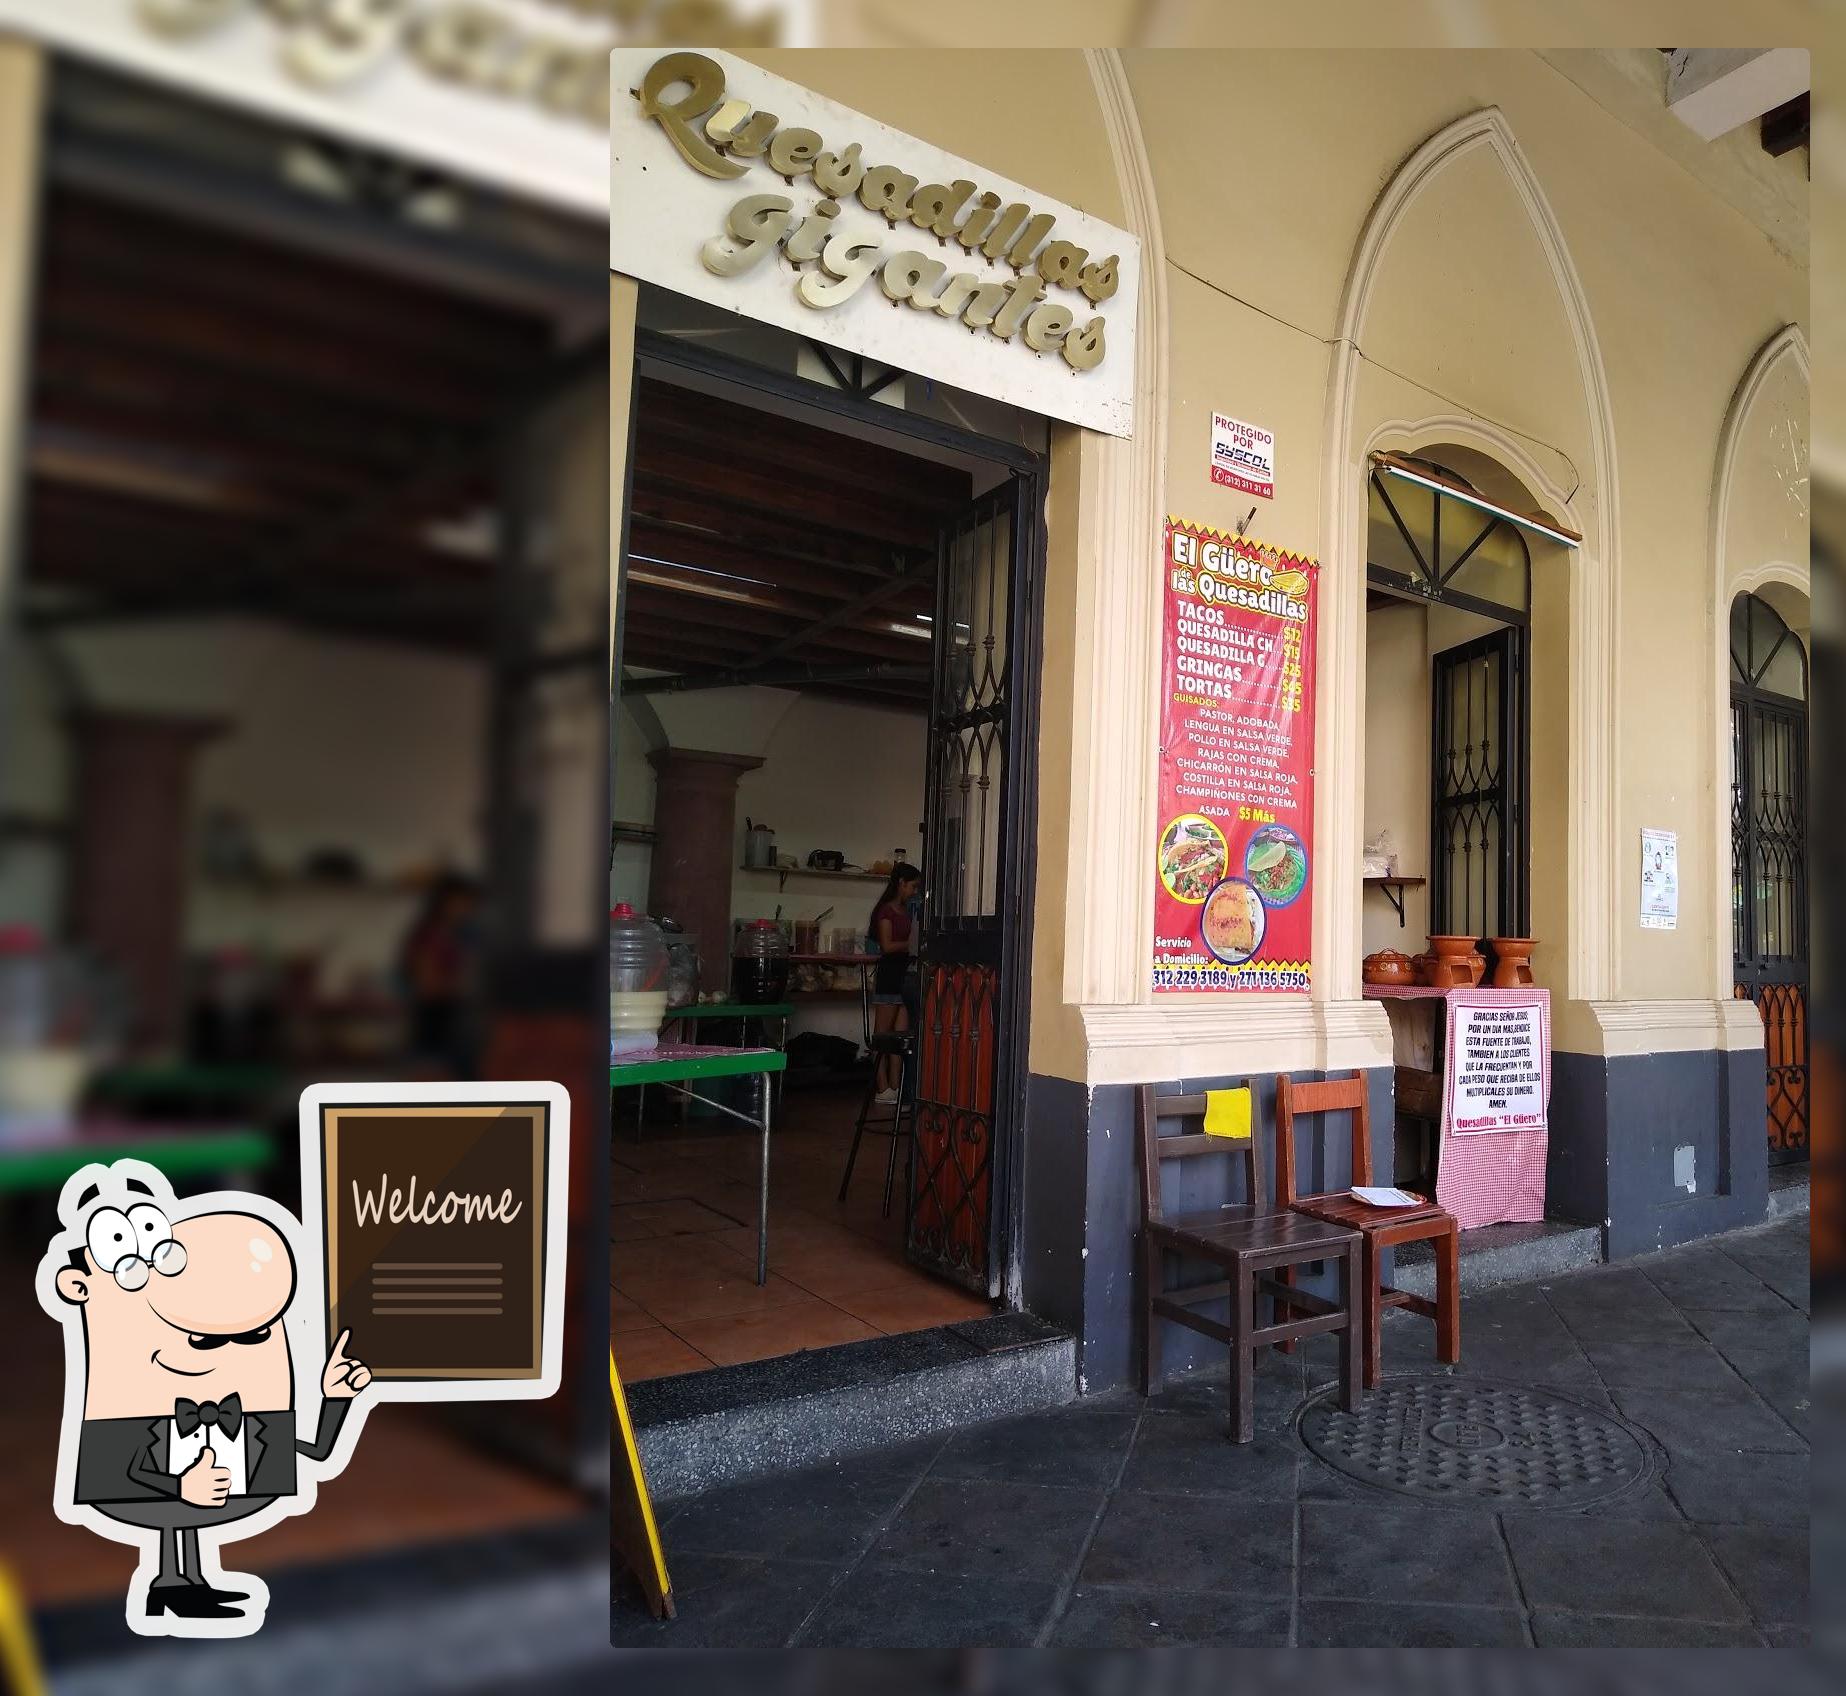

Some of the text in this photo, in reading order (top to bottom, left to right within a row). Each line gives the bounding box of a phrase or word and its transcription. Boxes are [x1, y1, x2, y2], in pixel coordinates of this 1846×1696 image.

[639, 51, 1120, 302] Quesadillas
[1215, 416, 1272, 444] PROTEGIDO
[1233, 434, 1253, 449] POR
[1215, 442, 1270, 470] SYSCOL
[1225, 475, 1240, 487] (312)
[1242, 480, 1252, 490] 311
[1174, 532, 1273, 586] El Güero
[1172, 570, 1195, 593] las
[1198, 572, 1307, 620] Quesadillas
[1177, 600, 1225, 625] TACOS
[1177, 619, 1254, 648] QUESADILLA
[1257, 637, 1273, 652] CH
[1177, 637, 1255, 664] QUESADILLA
[1177, 656, 1242, 682] GRINGAS
[1177, 675, 1232, 699] TORTAS
[1185, 719, 1220, 734] LENGUA
[1222, 726, 1235, 736] EN
[1237, 727, 1264, 740] SALSA
[1189, 732, 1216, 746] POLLO
[1219, 739, 1231, 749] EN
[1233, 740, 1260, 753] SALSA
[1198, 747, 1224, 761] RAJAS
[1226, 752, 1247, 763] CON
[1177, 758, 1232, 775] CHICARRÓN
[1234, 766, 1247, 776] EN
[1249, 768, 1273, 780] SALSA
[1183, 772, 1225, 786] COSTILLA
[1228, 778, 1240, 788] EN
[1243, 780, 1267, 792] SALSA
[1247, 794, 1265, 804] CON
[1267, 797, 1297, 809] CREMA
[1199, 805, 1275, 823] ASADA $5 Más
[1155, 936, 1192, 948] Servicio
[1154, 953, 1209, 964] a Domicilio:
[1153, 970, 1306, 988] 312 229 3189 y 271 136 5750
[1473, 1012, 1498, 1021] GRACIAS
[1500, 1011, 1515, 1021] SEÑOR
[1468, 1024, 1481, 1033] POR
[1482, 1025, 1491, 1033] UN
[1492, 1025, 1501, 1033] DIA
[1466, 1037, 1480, 1046] ESTA
[1482, 1037, 1504, 1046] FUENTE
[1505, 1037, 1511, 1046] DE
[1467, 1049, 1494, 1058] TAMBIEN
[1500, 1049, 1509, 1058] LOS
[1510, 1048, 1530, 1058] CLIENTES
[1466, 1062, 1475, 1071] QUE
[1476, 1062, 1483, 1071] LA
[1485, 1061, 1517, 1071] FRECUENTAN
[1523, 1061, 1532, 1069] POR
[1459, 1072, 1541, 1084] CADA PESO QUE RECIBA DE ELLOS
[1467, 1087, 1505, 1097] MULTIPLICALES
[1507, 1087, 1513, 1096] SU
[1489, 1100, 1507, 1108] AMEN.
[1457, 1116, 1497, 1129] Quesadillas
